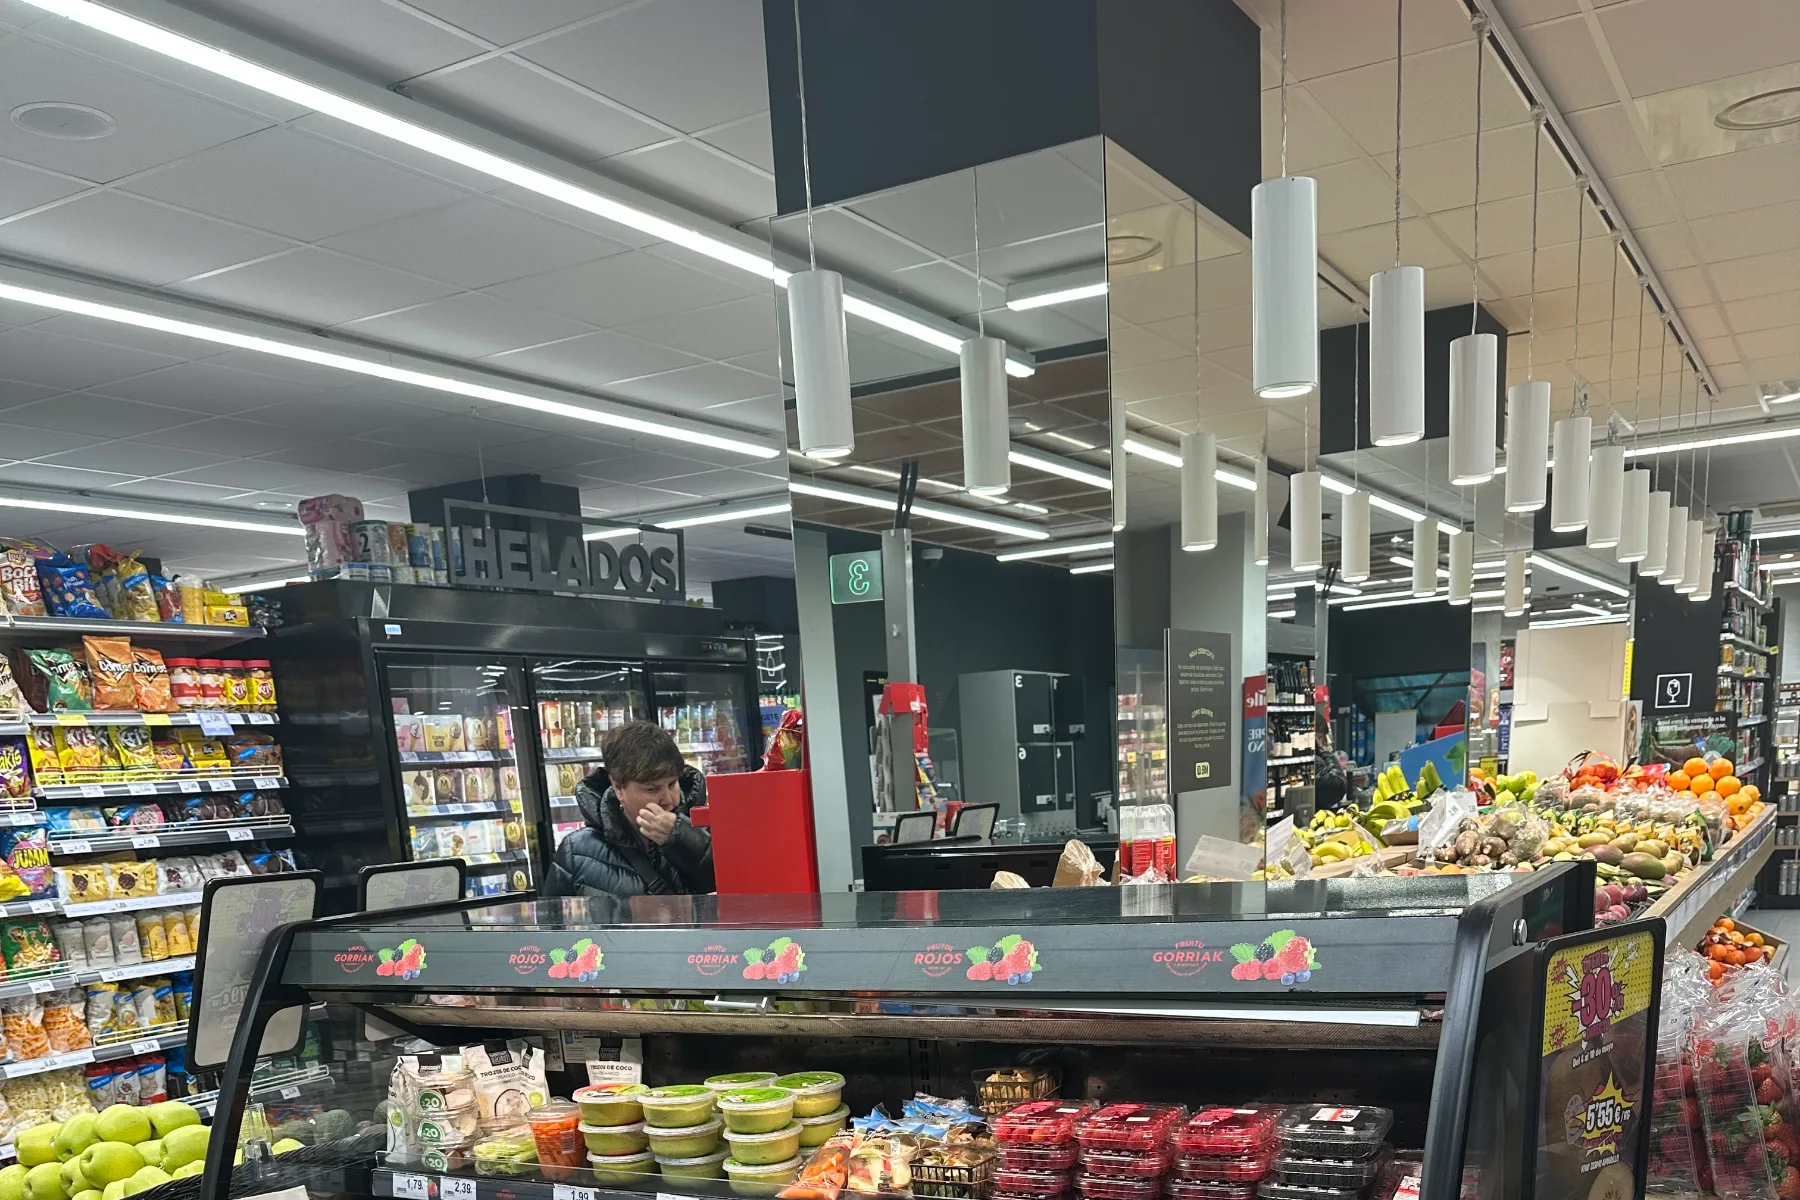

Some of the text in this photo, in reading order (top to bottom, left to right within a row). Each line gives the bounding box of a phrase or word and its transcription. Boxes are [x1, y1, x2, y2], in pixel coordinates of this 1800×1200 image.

[456, 525, 676, 592] HELADOS
[926, 943, 954, 952] FRUTOS
[1174, 940, 1206, 949] FRUITU
[334, 953, 375, 963] GORRIAK
[509, 954, 546, 964] ROJOS
[687, 953, 738, 965] GORRIAK
[913, 953, 962, 965] ROJOS
[1152, 951, 1224, 962] GORRIAK
